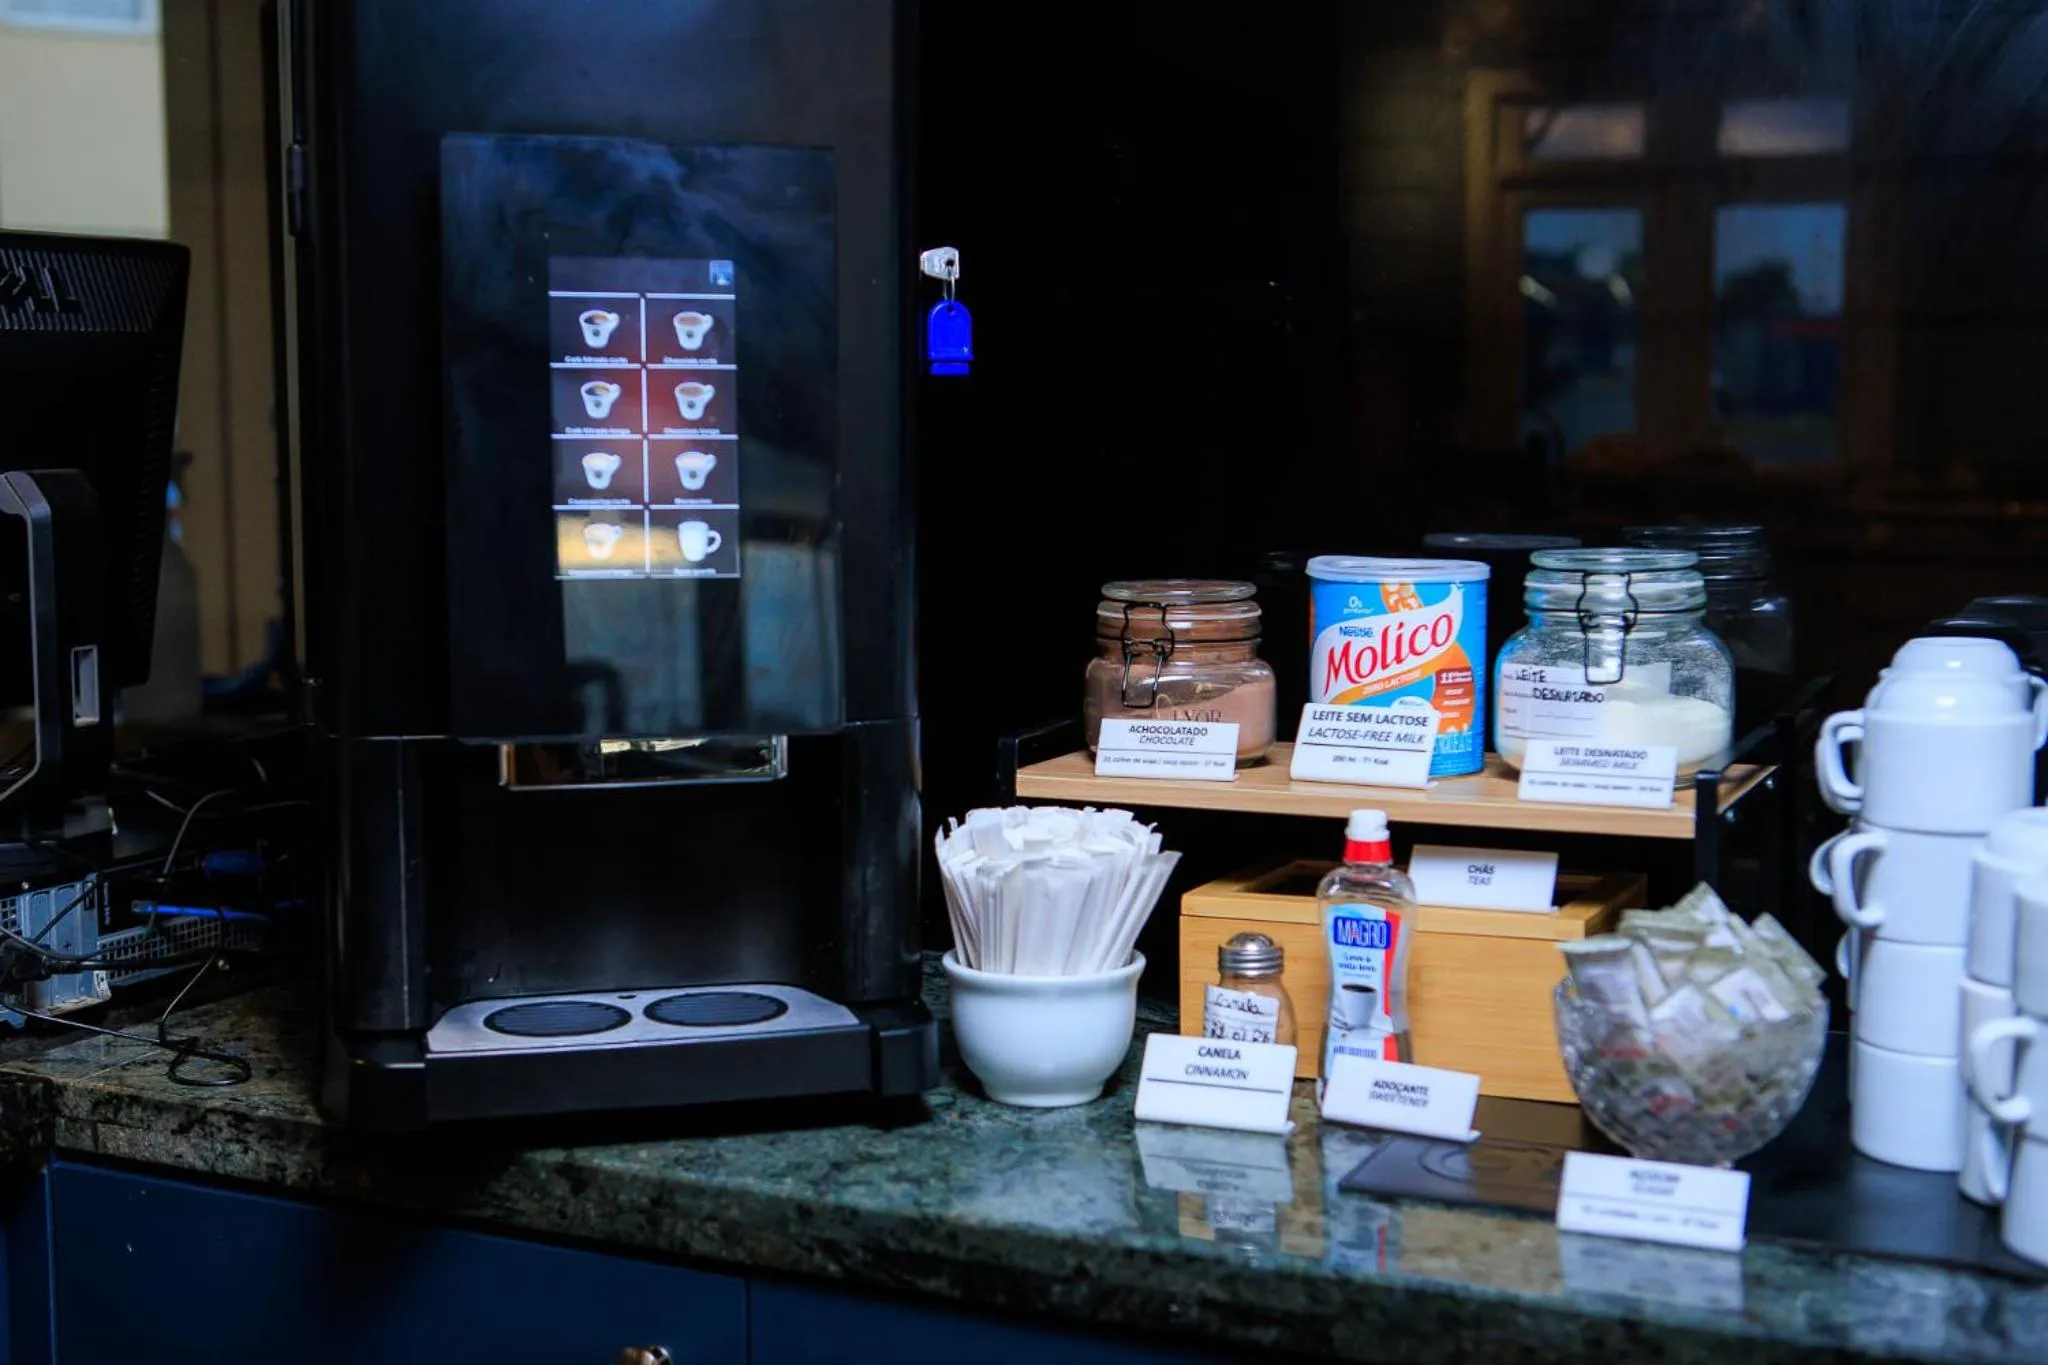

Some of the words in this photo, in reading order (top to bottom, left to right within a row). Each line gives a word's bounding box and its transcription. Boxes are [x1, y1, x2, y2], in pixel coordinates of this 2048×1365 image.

[1324, 613, 1453, 697] Molico
[1515, 667, 1547, 682] LEITE
[1532, 687, 1605, 703] DESNATADO
[1312, 710, 1344, 721] LEITE
[1346, 712, 1373, 723] SEM
[1376, 714, 1430, 727] LACTOSE
[1128, 725, 1208, 736] ACHOCOLATADO
[1308, 727, 1393, 742] LACTOSE-FREE
[1395, 733, 1427, 744] MILK
[1139, 735, 1195, 746] CHOCOLATE
[1554, 746, 1580, 757] LEITE
[1584, 747, 1648, 760] DESNATADO
[1336, 917, 1387, 945] MAGRO
[1198, 1046, 1241, 1060] CANELA
[1184, 1064, 1249, 1080] CINNAMON
